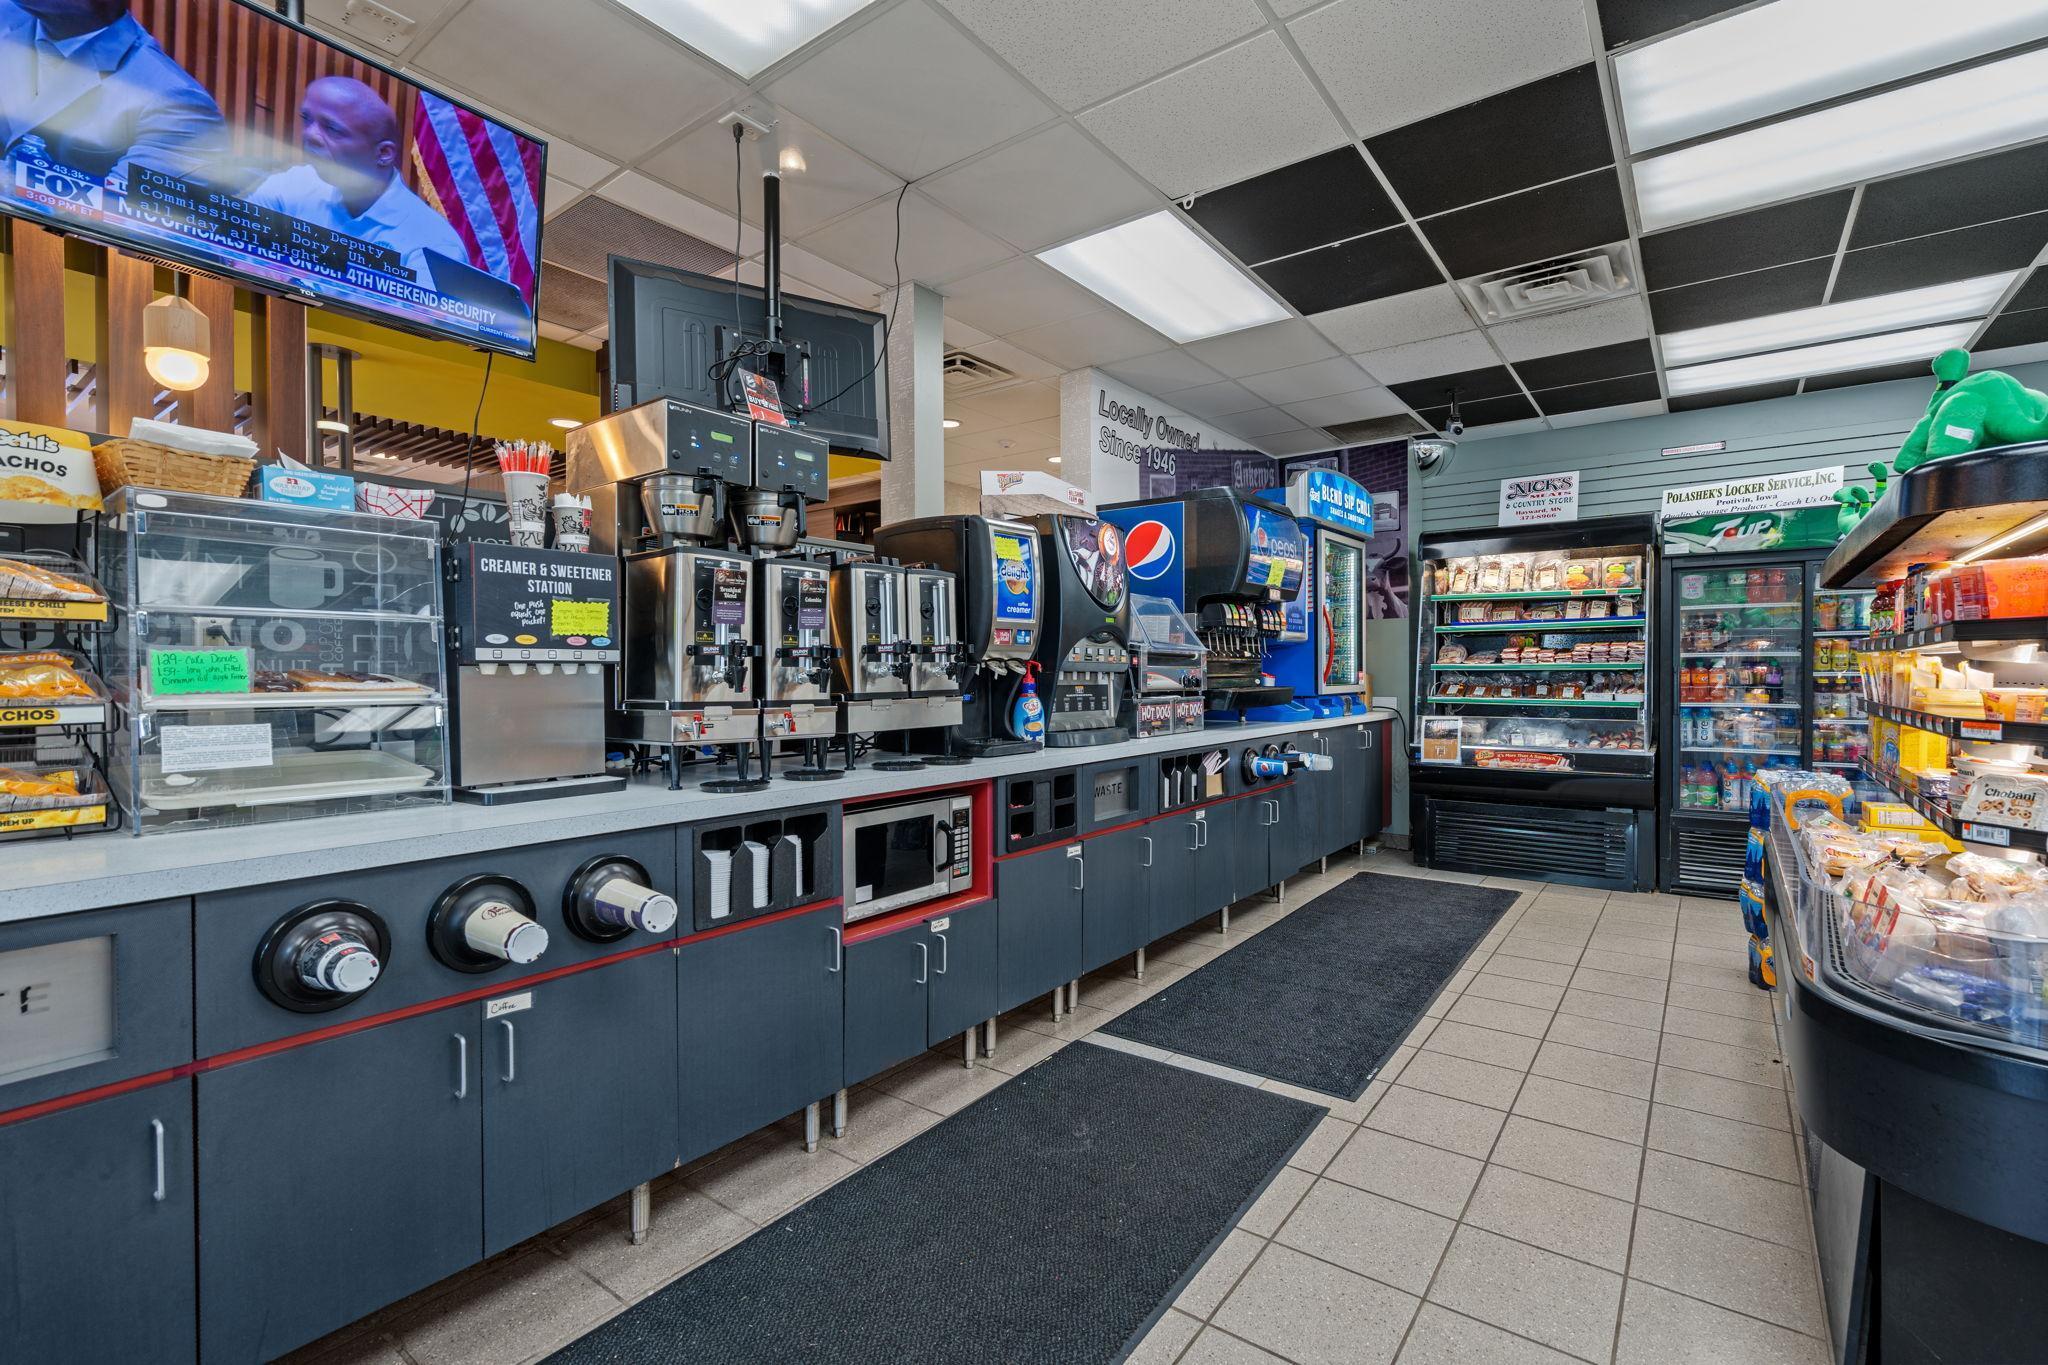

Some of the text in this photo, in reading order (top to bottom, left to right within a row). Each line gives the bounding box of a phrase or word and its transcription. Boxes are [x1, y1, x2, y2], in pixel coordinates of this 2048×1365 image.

[26, 165, 95, 206] FOX
[58, 199, 76, 213] PM
[80, 206, 94, 217] ET
[141, 170, 187, 193] John
[293, 221, 319, 238] uh,
[330, 231, 385, 259] Deputy
[140, 184, 279, 237] Commissioner.
[383, 262, 410, 278] how
[140, 200, 327, 265] all day all night.
[347, 268, 373, 289] 4TH
[376, 276, 439, 308] WEEKEND
[440, 299, 497, 325] SECURITY
[1099, 389, 1200, 454] Locally Owned
[1099, 426, 1176, 476] Since 1946
[1322, 484, 1342, 506] BLEND
[1344, 493, 1354, 510] SIP
[1506, 476, 1573, 500] NICK'S
[1667, 488, 1722, 504] POLASHEK'S
[1726, 482, 1764, 496] LOCKER
[1513, 500, 1545, 508] COUNTRY
[1549, 497, 1573, 505] STORE
[1696, 508, 1728, 517] Sausage
[1730, 503, 1767, 513] Products
[1775, 499, 1801, 507] Czech
[1271, 539, 1296, 558] pepsi
[481, 558, 612, 581] CREAMER & SWEETENER
[1001, 565, 1028, 580] delight
[528, 580, 572, 594] STATION
[510, 609, 532, 619] equals
[514, 600, 544, 610] One push
[210, 653, 238, 663] Donuts
[1821, 646, 1829, 664] C4
[1142, 705, 1170, 721] HOT DOGS
[1177, 703, 1203, 718] HOT DOGS
[1094, 782, 1122, 798] WASTE
[1984, 787, 2037, 801] Chobani
[490, 1002, 517, 1014] Coffee
